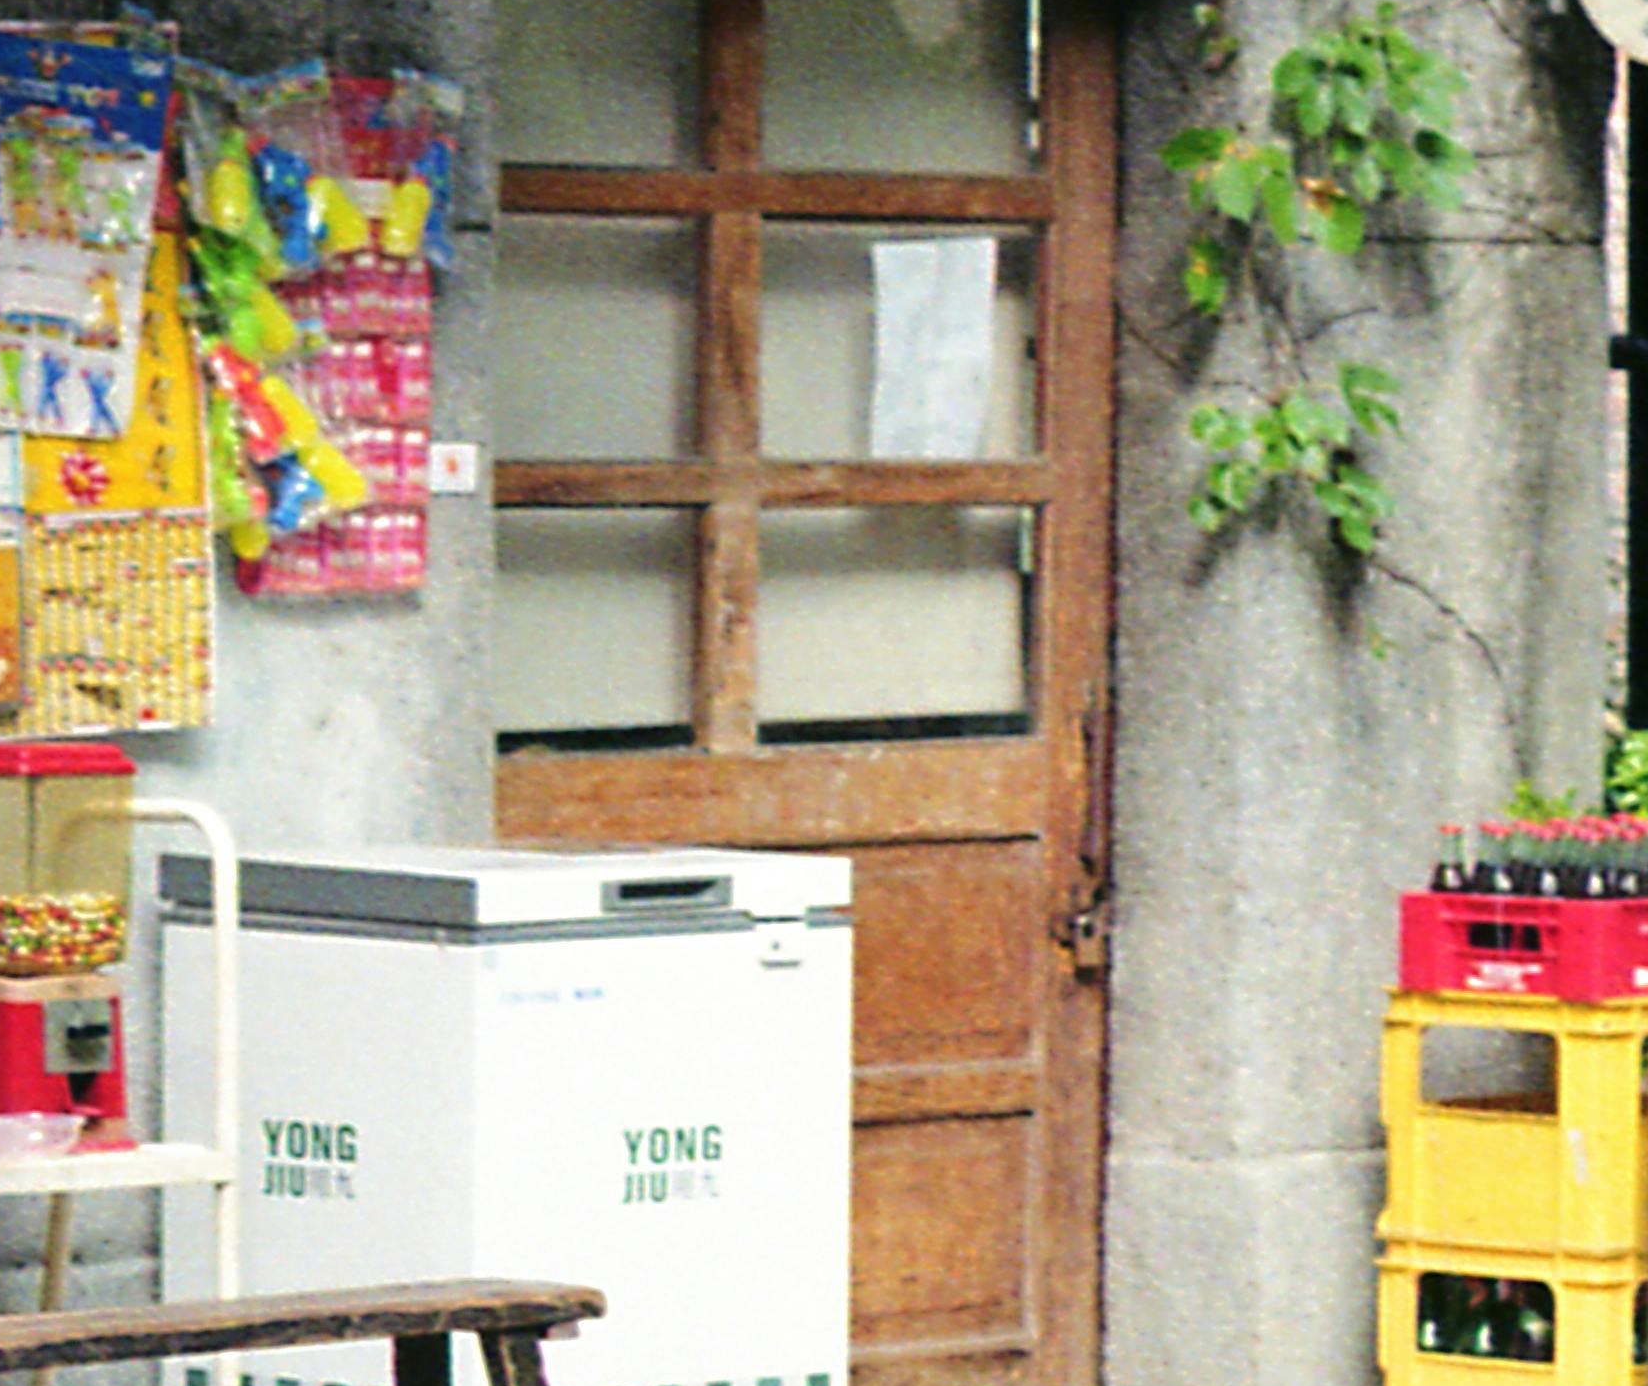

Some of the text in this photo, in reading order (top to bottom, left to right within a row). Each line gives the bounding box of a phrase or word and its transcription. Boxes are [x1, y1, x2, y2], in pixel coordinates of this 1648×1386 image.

[262, 1117, 358, 1163] YONG
[622, 1123, 723, 1165] YONG
[262, 1164, 307, 1199] JIU
[621, 1170, 669, 1205] JIU
